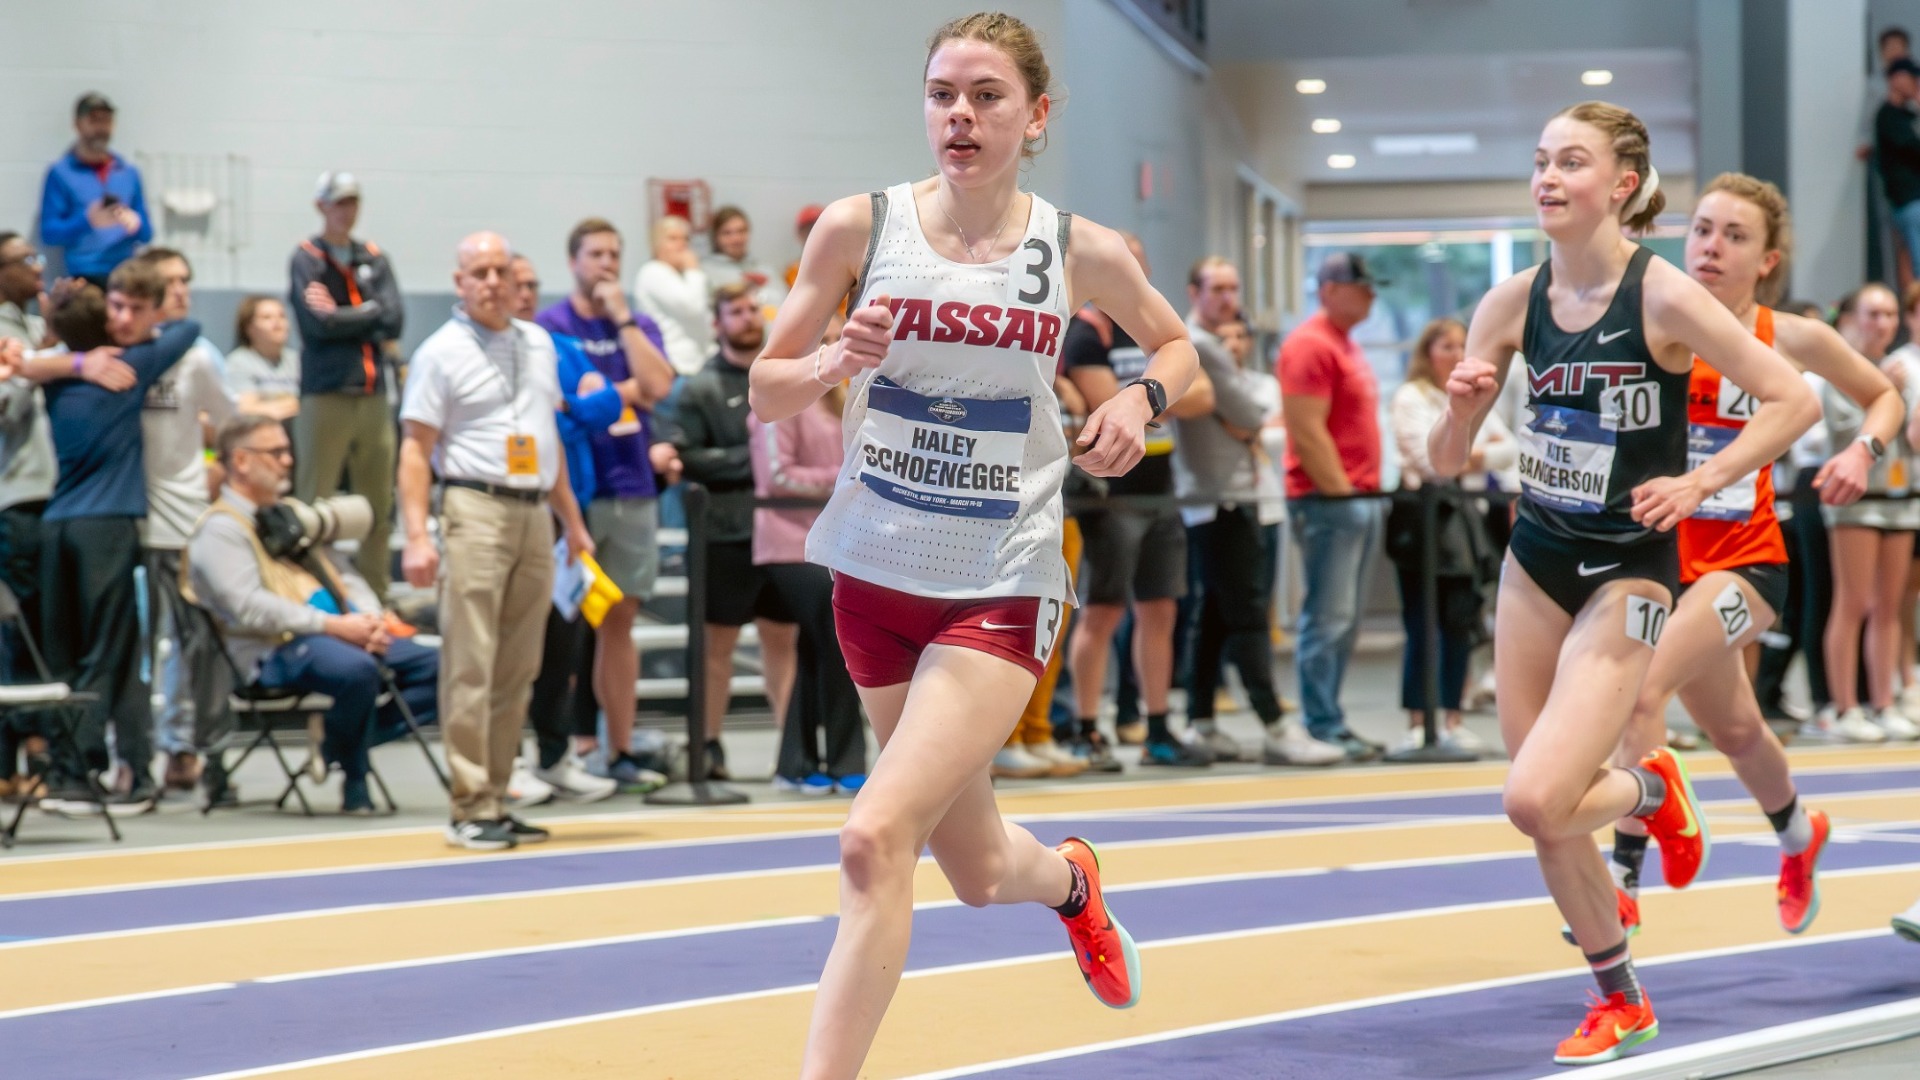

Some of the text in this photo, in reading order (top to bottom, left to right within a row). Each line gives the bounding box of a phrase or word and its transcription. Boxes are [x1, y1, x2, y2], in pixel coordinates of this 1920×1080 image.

[1018, 238, 1053, 305] 3
[1527, 362, 1646, 398] MIT
[1613, 387, 1651, 427] 10
[911, 427, 977, 458] HALEY
[863, 444, 1020, 492] SCHOENEGGE
[932, 496, 947, 504] YORK
[949, 498, 969, 506] MARCH
[1041, 597, 1060, 660] 3
[1638, 602, 1665, 646] 10
[1720, 591, 1748, 635] 20
